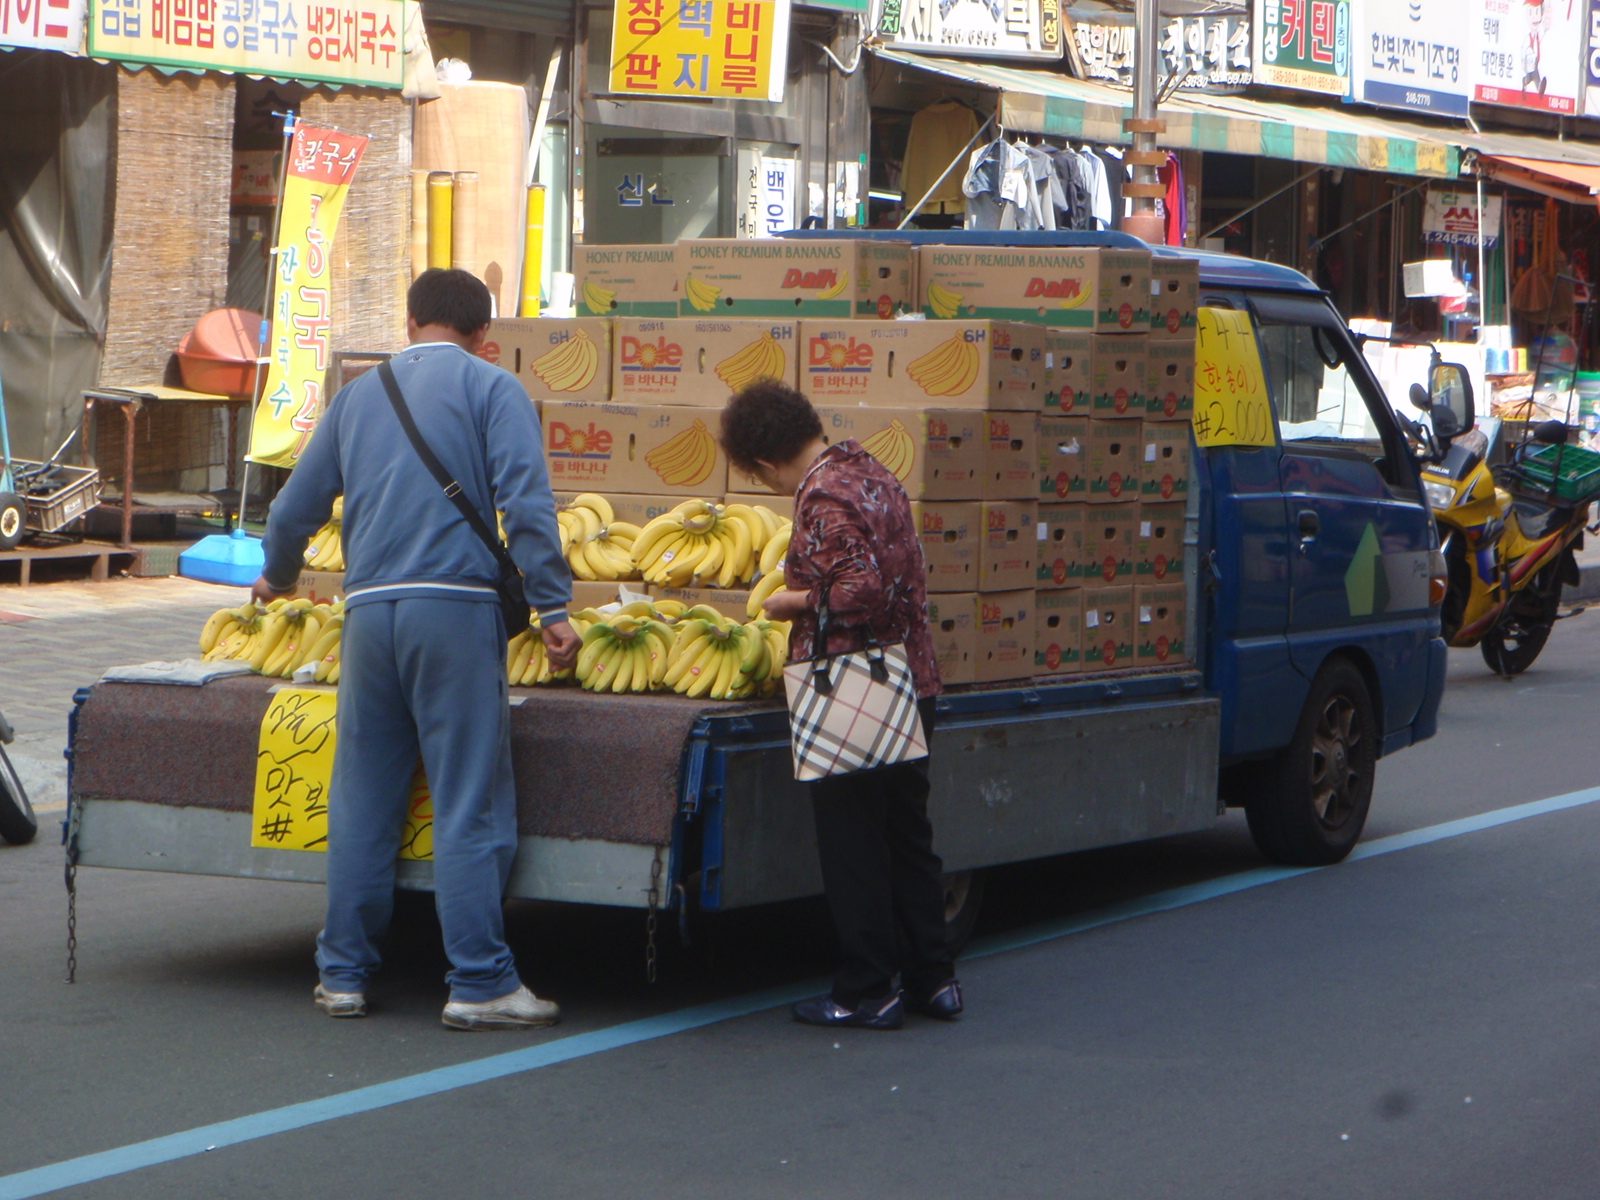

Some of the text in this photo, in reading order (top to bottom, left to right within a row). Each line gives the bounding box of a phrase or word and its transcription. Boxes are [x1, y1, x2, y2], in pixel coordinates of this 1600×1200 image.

[222, 0, 298, 57] 콩칼국수
[307, 5, 396, 68] 냉김치국수
[1281, 0, 1335, 65] 커텐
[720, 2, 761, 94] 비니루
[1371, 32, 1460, 83] 한빛전기조명
[303, 140, 358, 177] 칼국수
[1443, 207, 1487, 234] 쌀
[586, 250, 674, 264] HONEY PREMIUM
[690, 246, 841, 260] HONEY PREMIUM BANANAS
[933, 254, 1085, 269] HONEY PREMIUM BANANAS
[269, 247, 299, 417] 잔치국수
[549, 330, 570, 345] 6H
[771, 326, 793, 340] 6H
[963, 329, 986, 343] 6H
[621, 336, 684, 366] Dole
[809, 336, 874, 367] Dole
[638, 373, 677, 387] 바나나
[827, 375, 868, 388] 바나나
[549, 421, 613, 455] Dole
[567, 460, 608, 475] 바나나
